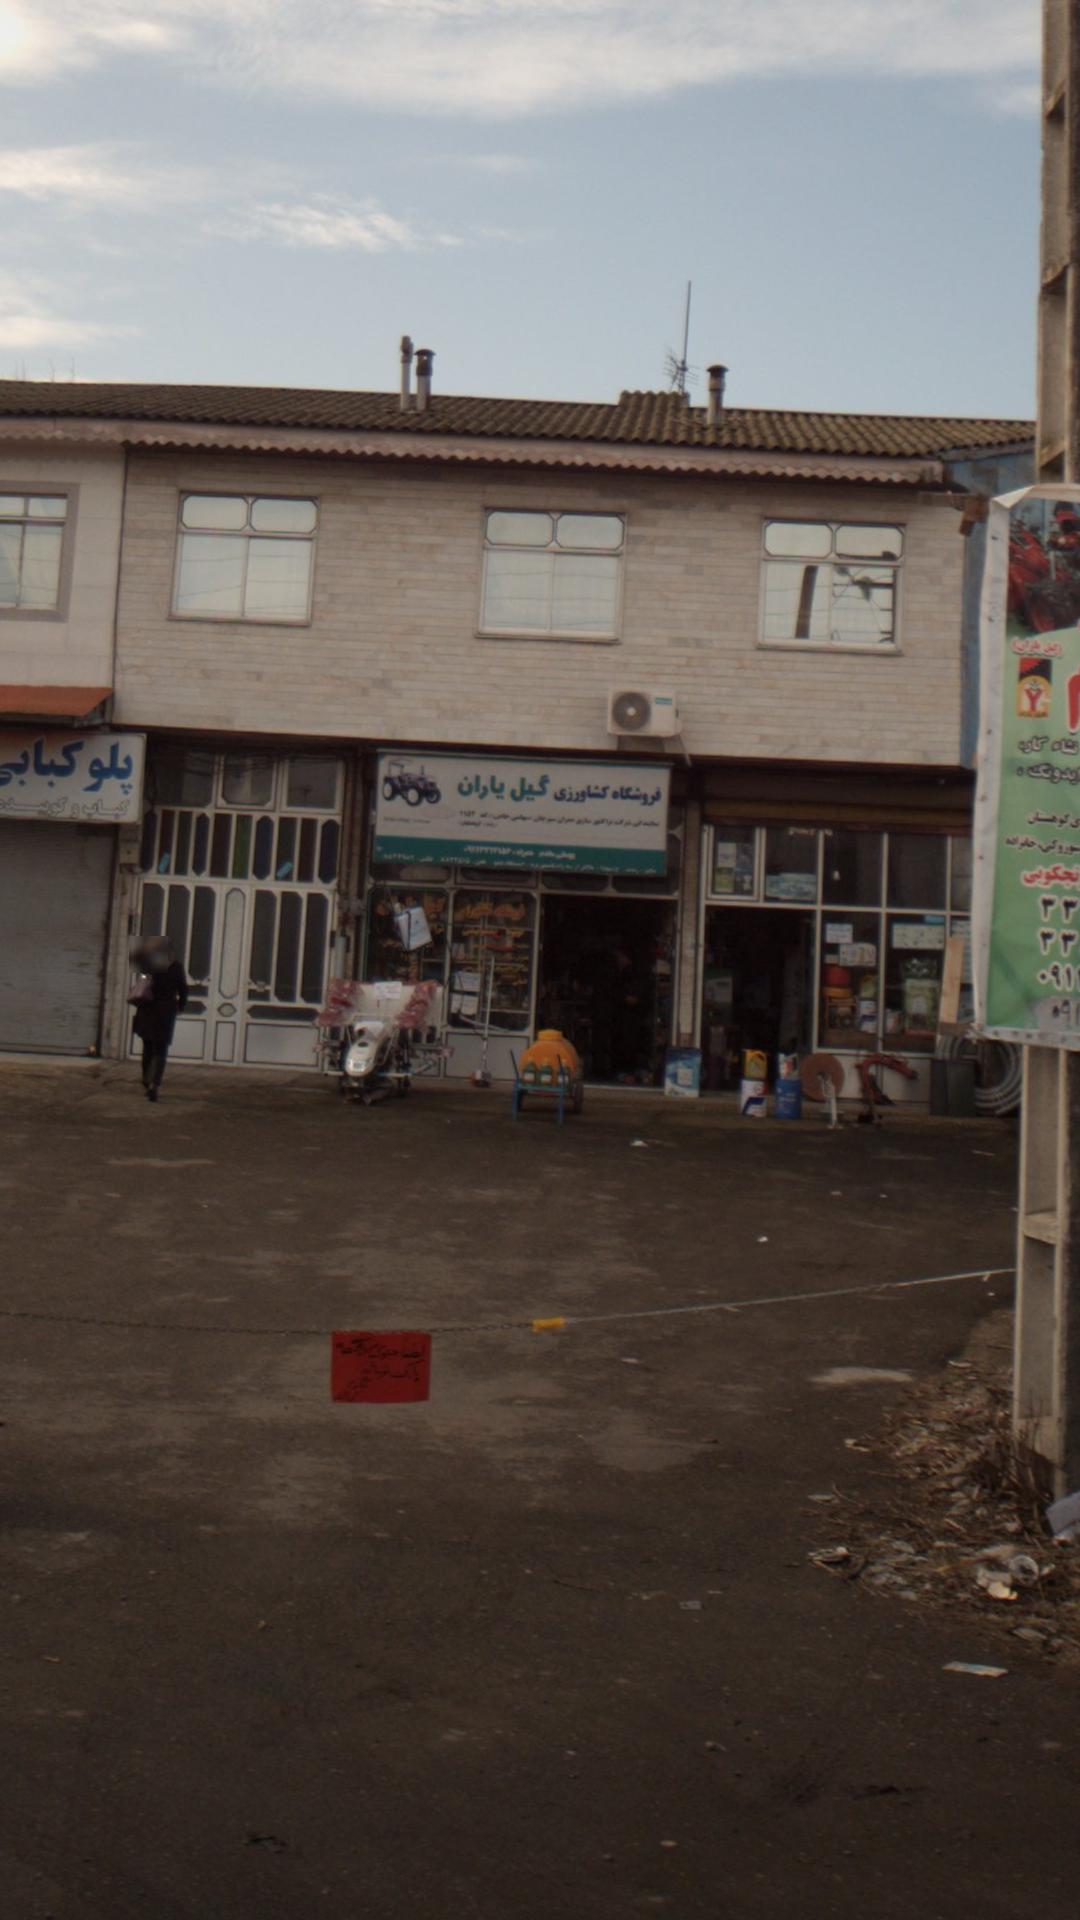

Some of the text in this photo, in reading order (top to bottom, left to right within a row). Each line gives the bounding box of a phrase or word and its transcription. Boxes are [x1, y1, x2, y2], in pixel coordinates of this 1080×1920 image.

[0, 739, 133, 795] پلو کبابی
[457, 773, 661, 806] فروشگاه کشاورزی گیل یاران
